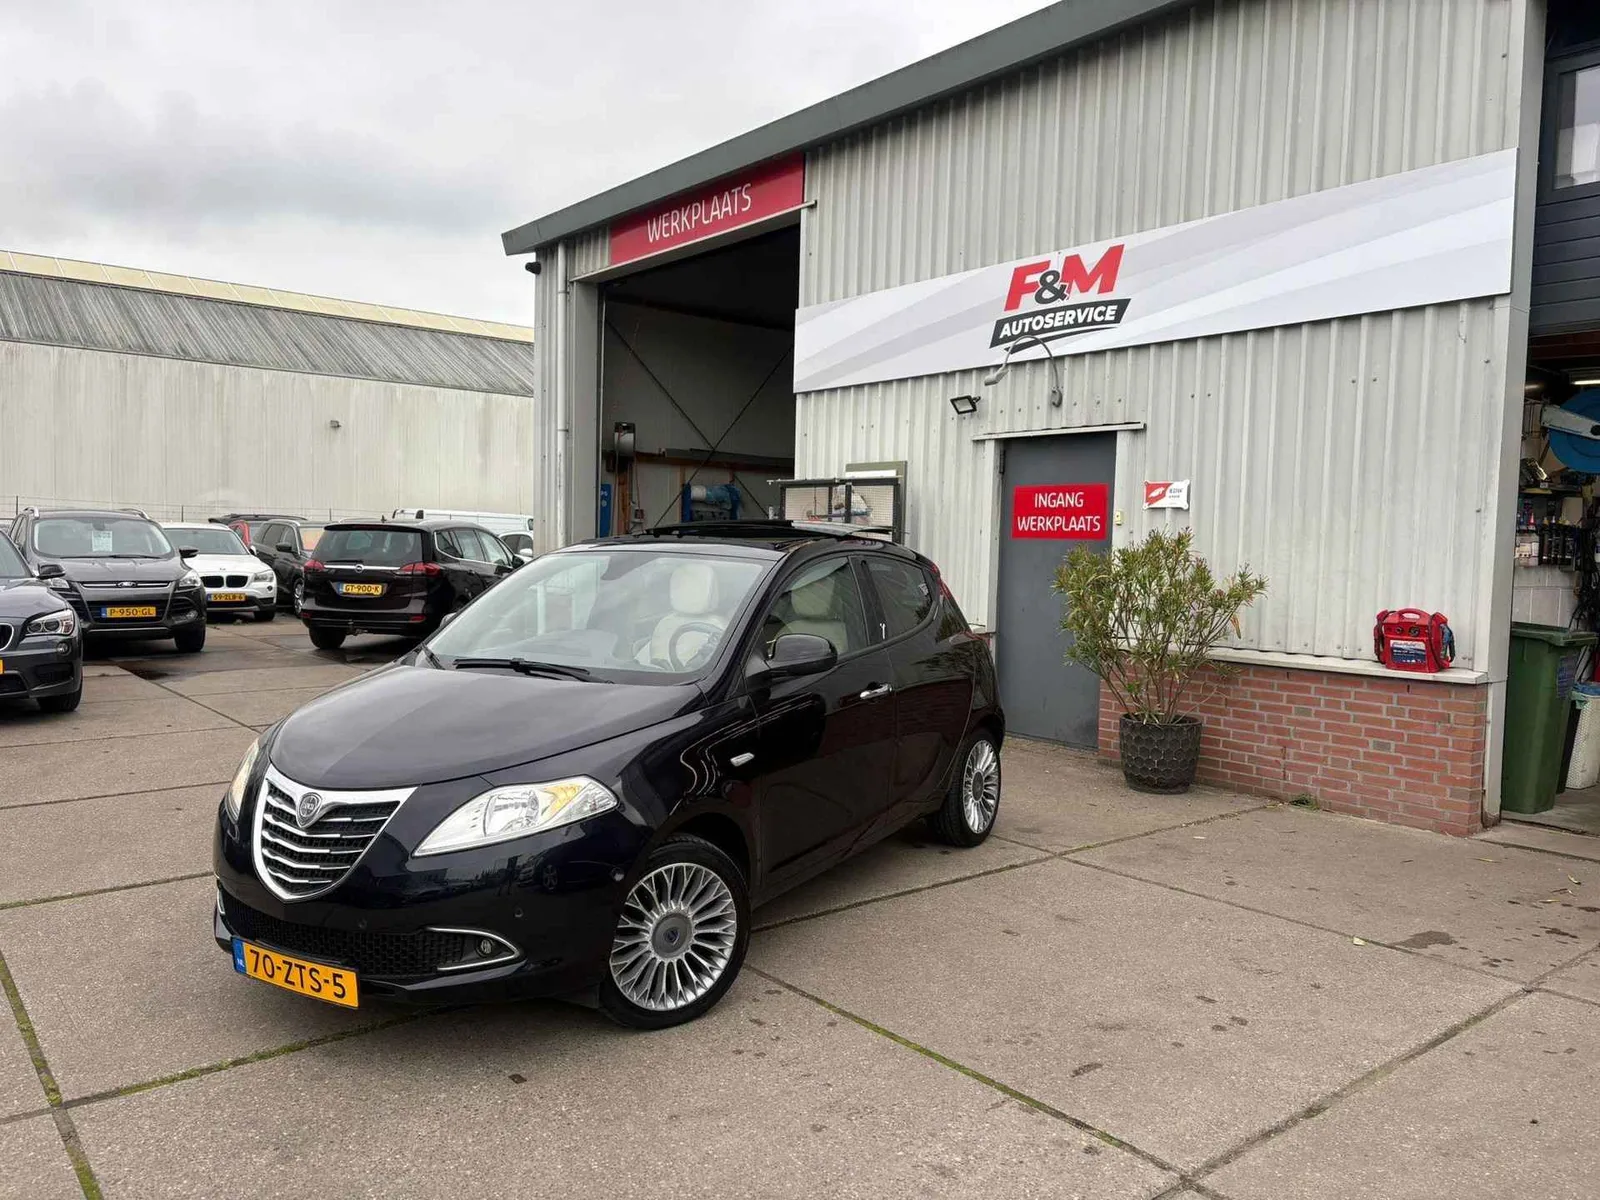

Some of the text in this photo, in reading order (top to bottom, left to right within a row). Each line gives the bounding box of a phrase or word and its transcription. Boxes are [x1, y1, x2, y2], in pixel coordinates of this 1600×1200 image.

[647, 183, 752, 243] WERKPLAATS
[1004, 244, 1125, 312] F&M
[999, 305, 1118, 339] AUTOSERVICE
[1034, 492, 1085, 508] INGANG
[1017, 515, 1101, 532] WERKPLAATS
[345, 584, 380, 593] GT-900-K
[109, 608, 153, 617] P-950-GL
[249, 949, 346, 999] 70-ZTS-5
